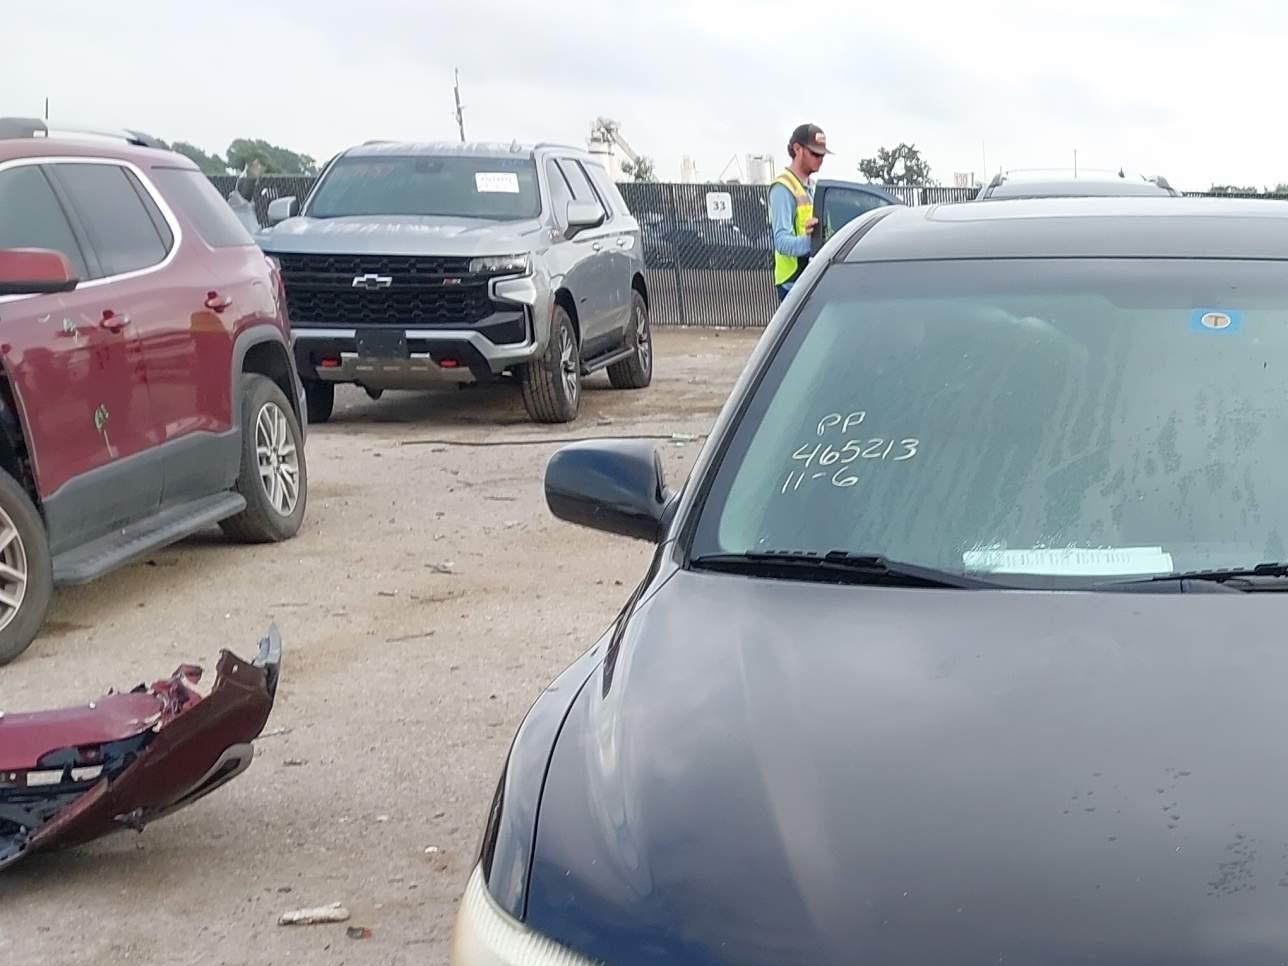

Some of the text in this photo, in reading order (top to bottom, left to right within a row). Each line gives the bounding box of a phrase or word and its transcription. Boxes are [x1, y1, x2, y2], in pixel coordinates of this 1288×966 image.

[712, 200, 727, 211] 33
[791, 438, 920, 468] 465213
[781, 465, 860, 495] 11-6
